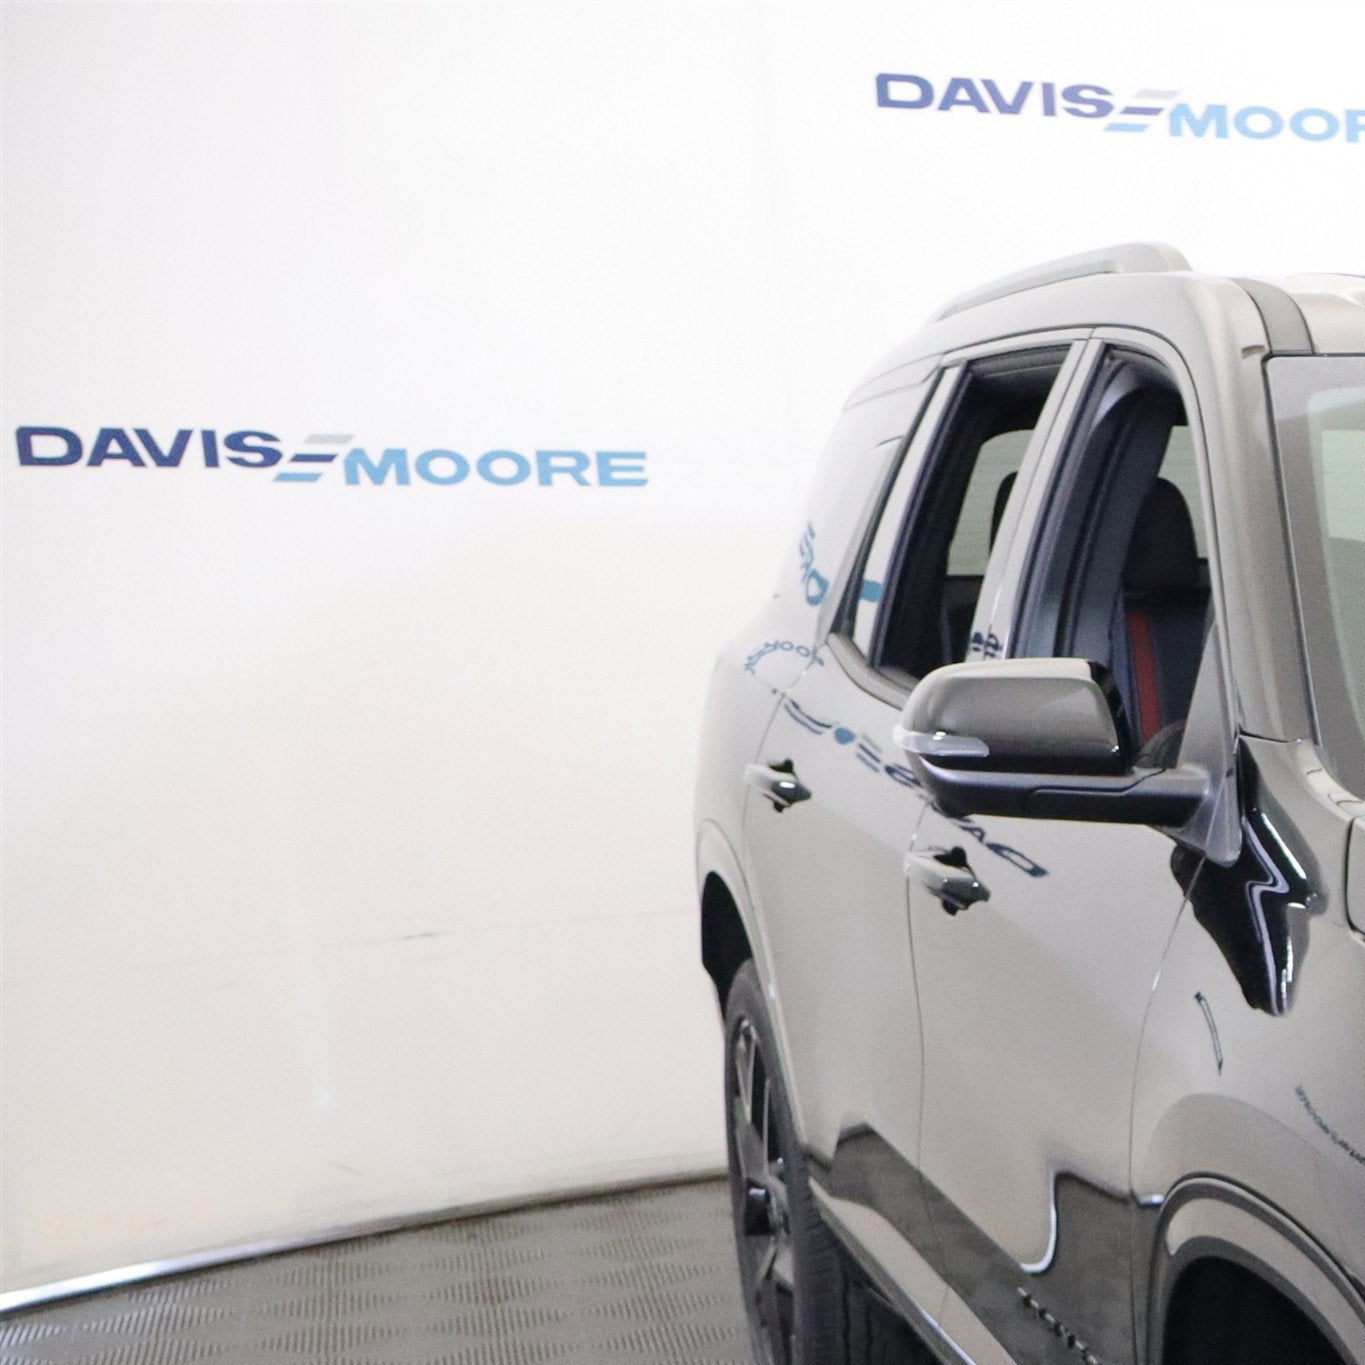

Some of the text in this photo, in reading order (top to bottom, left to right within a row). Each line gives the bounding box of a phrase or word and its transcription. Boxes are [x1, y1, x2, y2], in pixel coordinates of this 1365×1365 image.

[875, 72, 1115, 119] DAVIS
[15, 426, 649, 487] DAVIS MOORE
